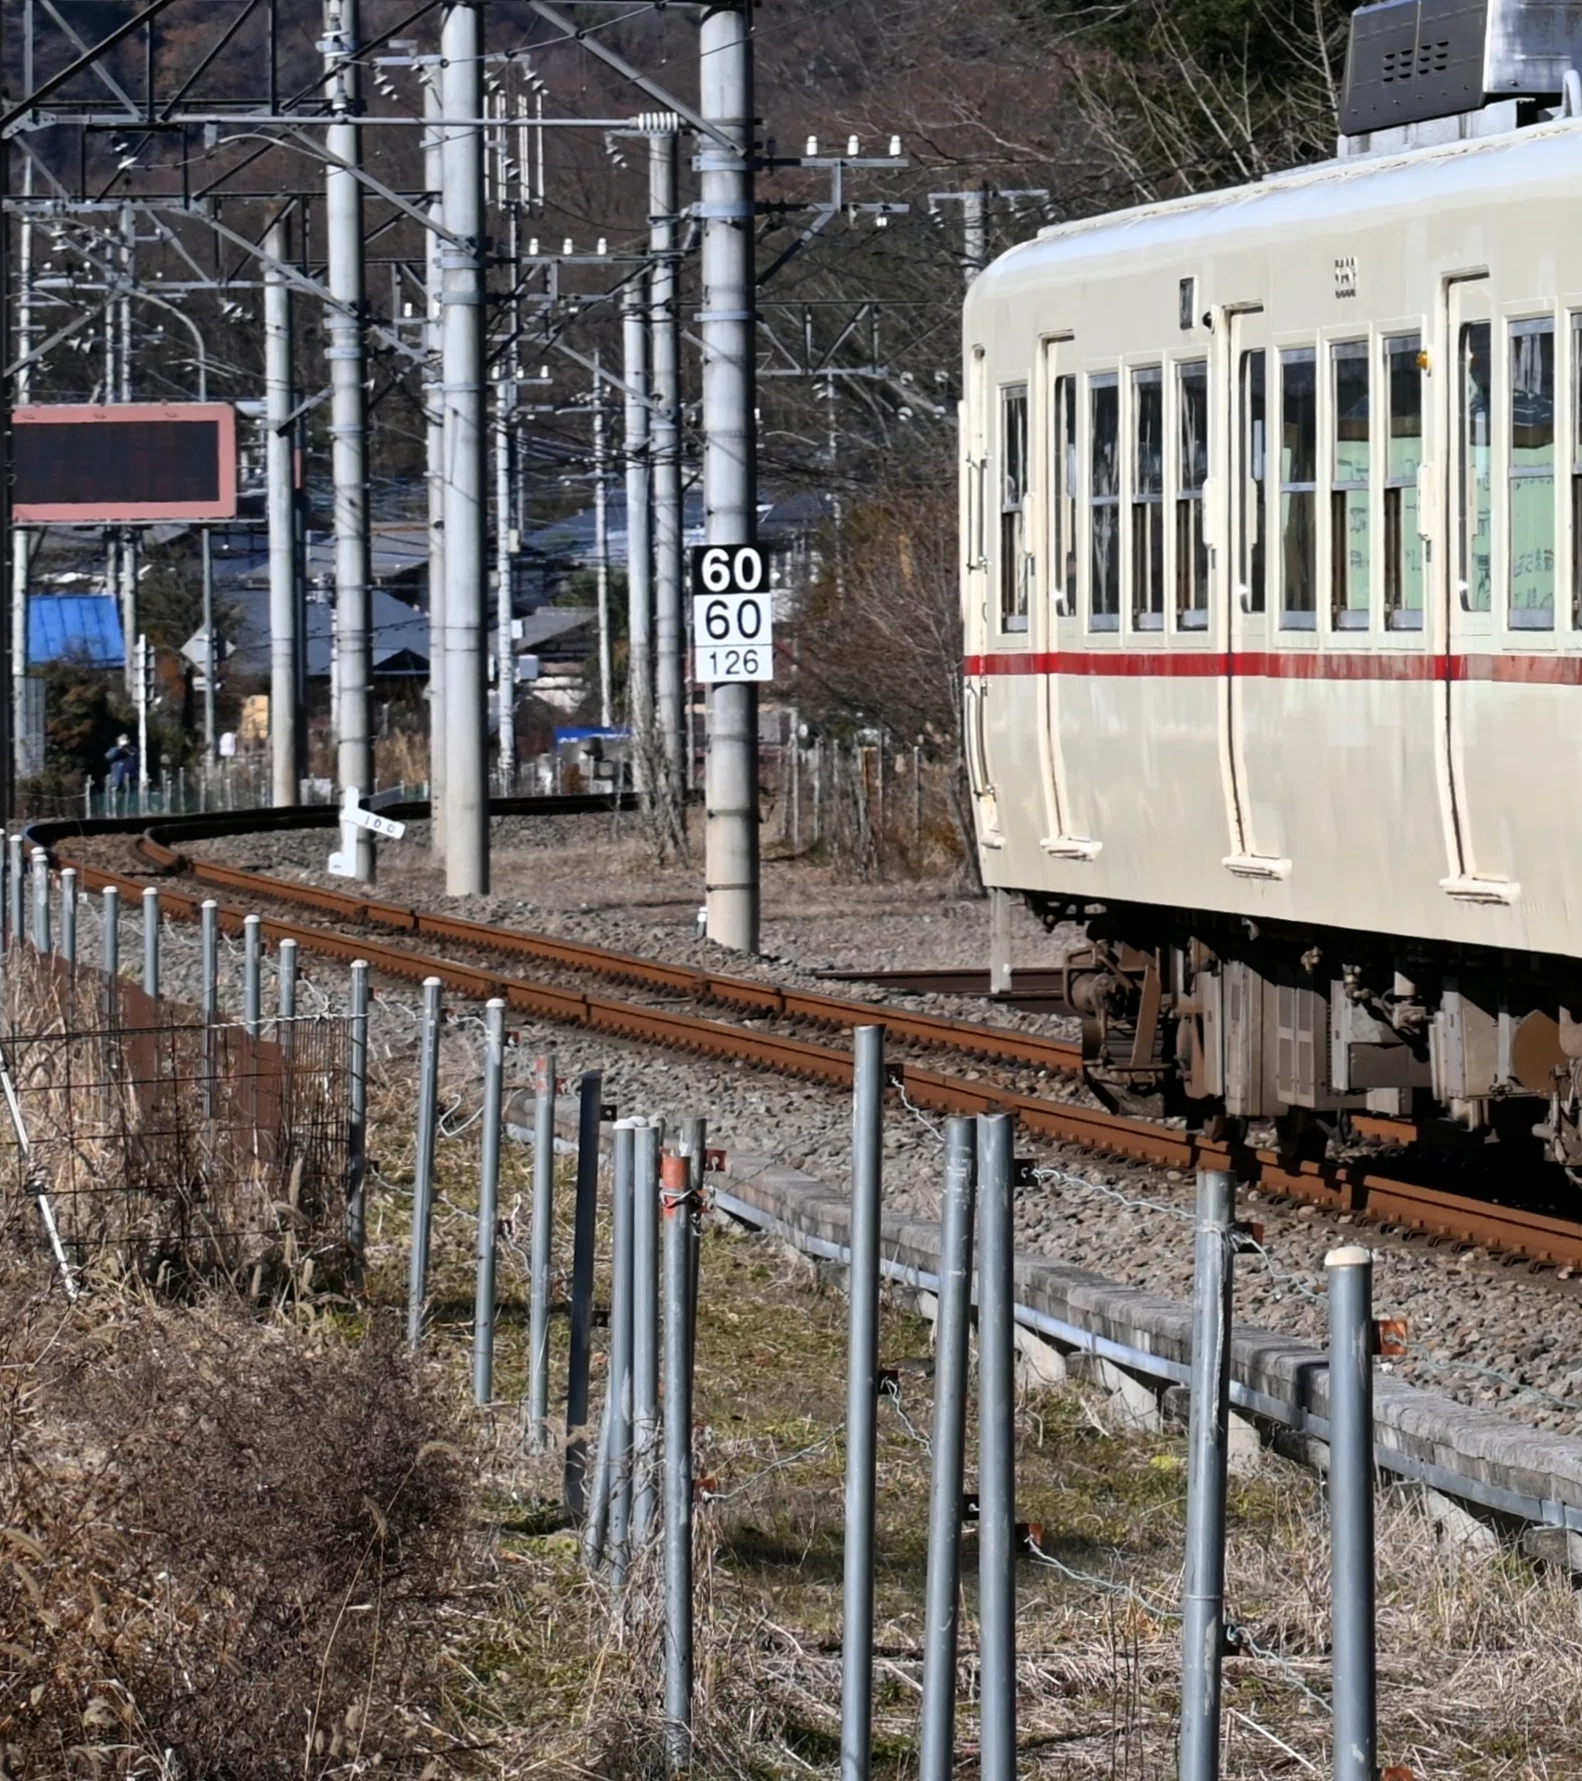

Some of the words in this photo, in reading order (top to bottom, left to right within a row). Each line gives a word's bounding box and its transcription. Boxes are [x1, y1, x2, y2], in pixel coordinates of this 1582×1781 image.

[701, 547, 762, 593] 60
[705, 599, 762, 640] 60
[709, 649, 759, 675] 126
